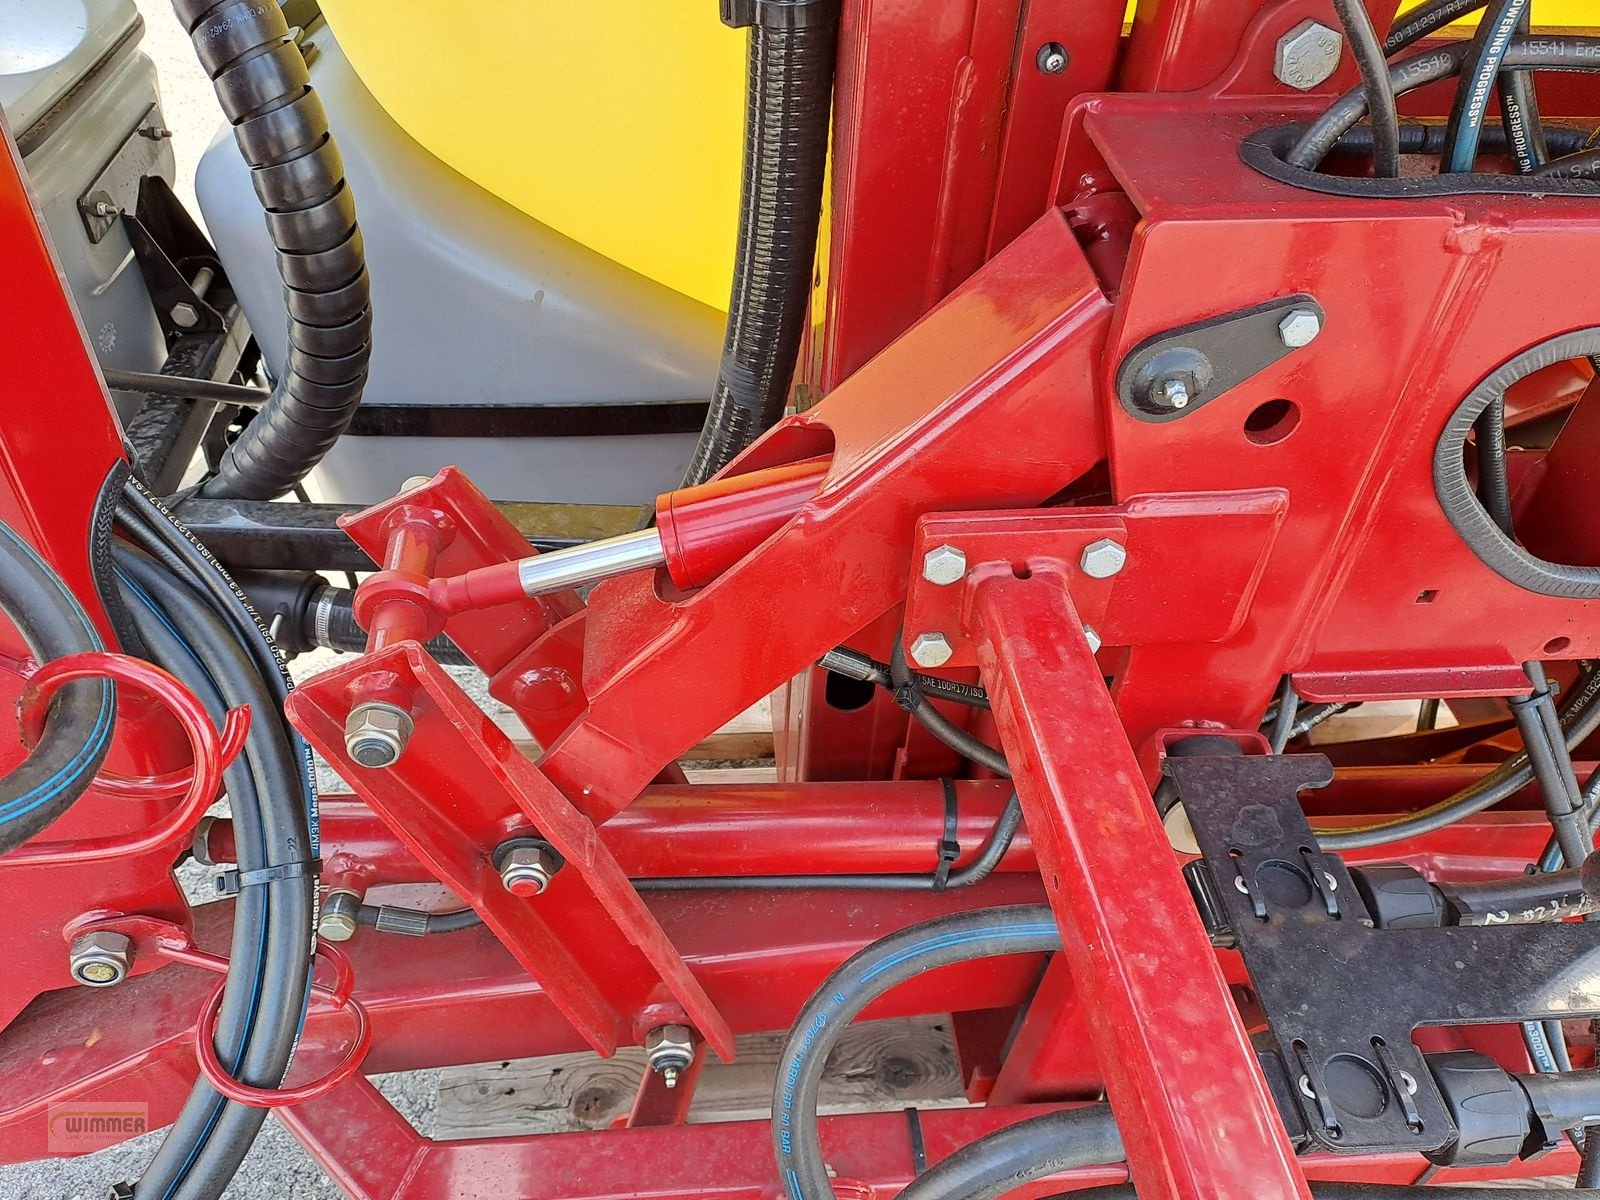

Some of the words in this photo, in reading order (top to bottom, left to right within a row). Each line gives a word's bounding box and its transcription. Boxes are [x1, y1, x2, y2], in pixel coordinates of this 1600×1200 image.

[1405, 9, 1442, 38] 11237
[1521, 41, 1566, 56] 15541
[1399, 52, 1452, 82] 15540
[148, 496, 169, 515] R17
[167, 514, 198, 544] 11237
[195, 541, 212, 560] ISO
[921, 675, 937, 688] SAE
[311, 820, 320, 850] 4M3K
[780, 1129, 793, 1154] BAR
